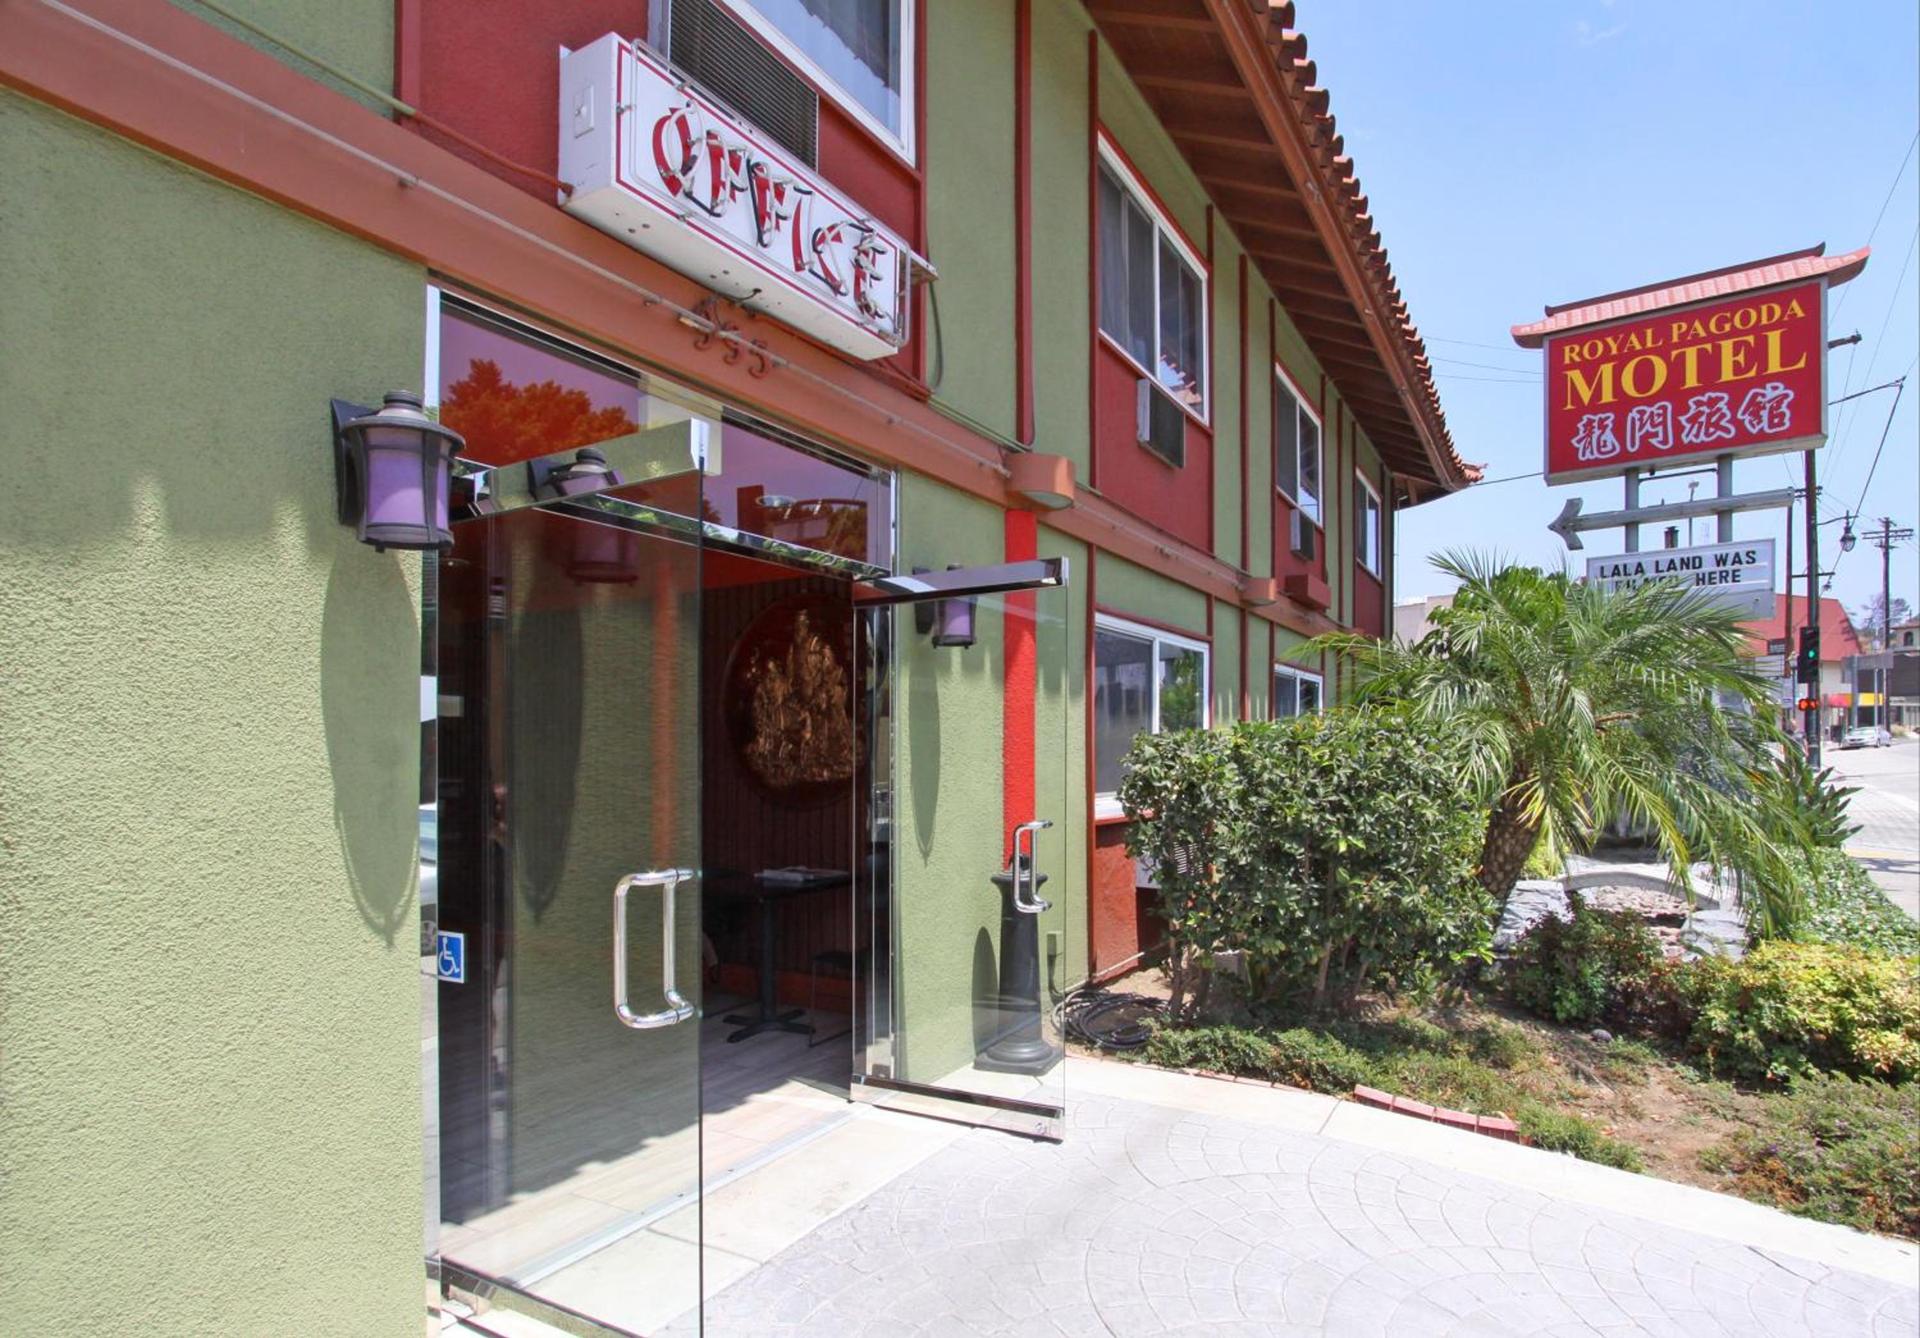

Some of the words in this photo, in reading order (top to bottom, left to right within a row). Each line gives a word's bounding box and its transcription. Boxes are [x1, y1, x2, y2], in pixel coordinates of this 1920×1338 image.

[652, 101, 886, 318] OFFICE
[1564, 329, 1662, 364] ROYAL
[1672, 300, 1805, 343] PAGODA
[1564, 329, 1806, 410] MOTEL
[1572, 384, 1794, 461] 龍門旅館
[1600, 562, 1644, 579] LALA
[1655, 555, 1703, 574] LAND
[1714, 550, 1756, 568] WAS
[1695, 569, 1741, 587] HERE
